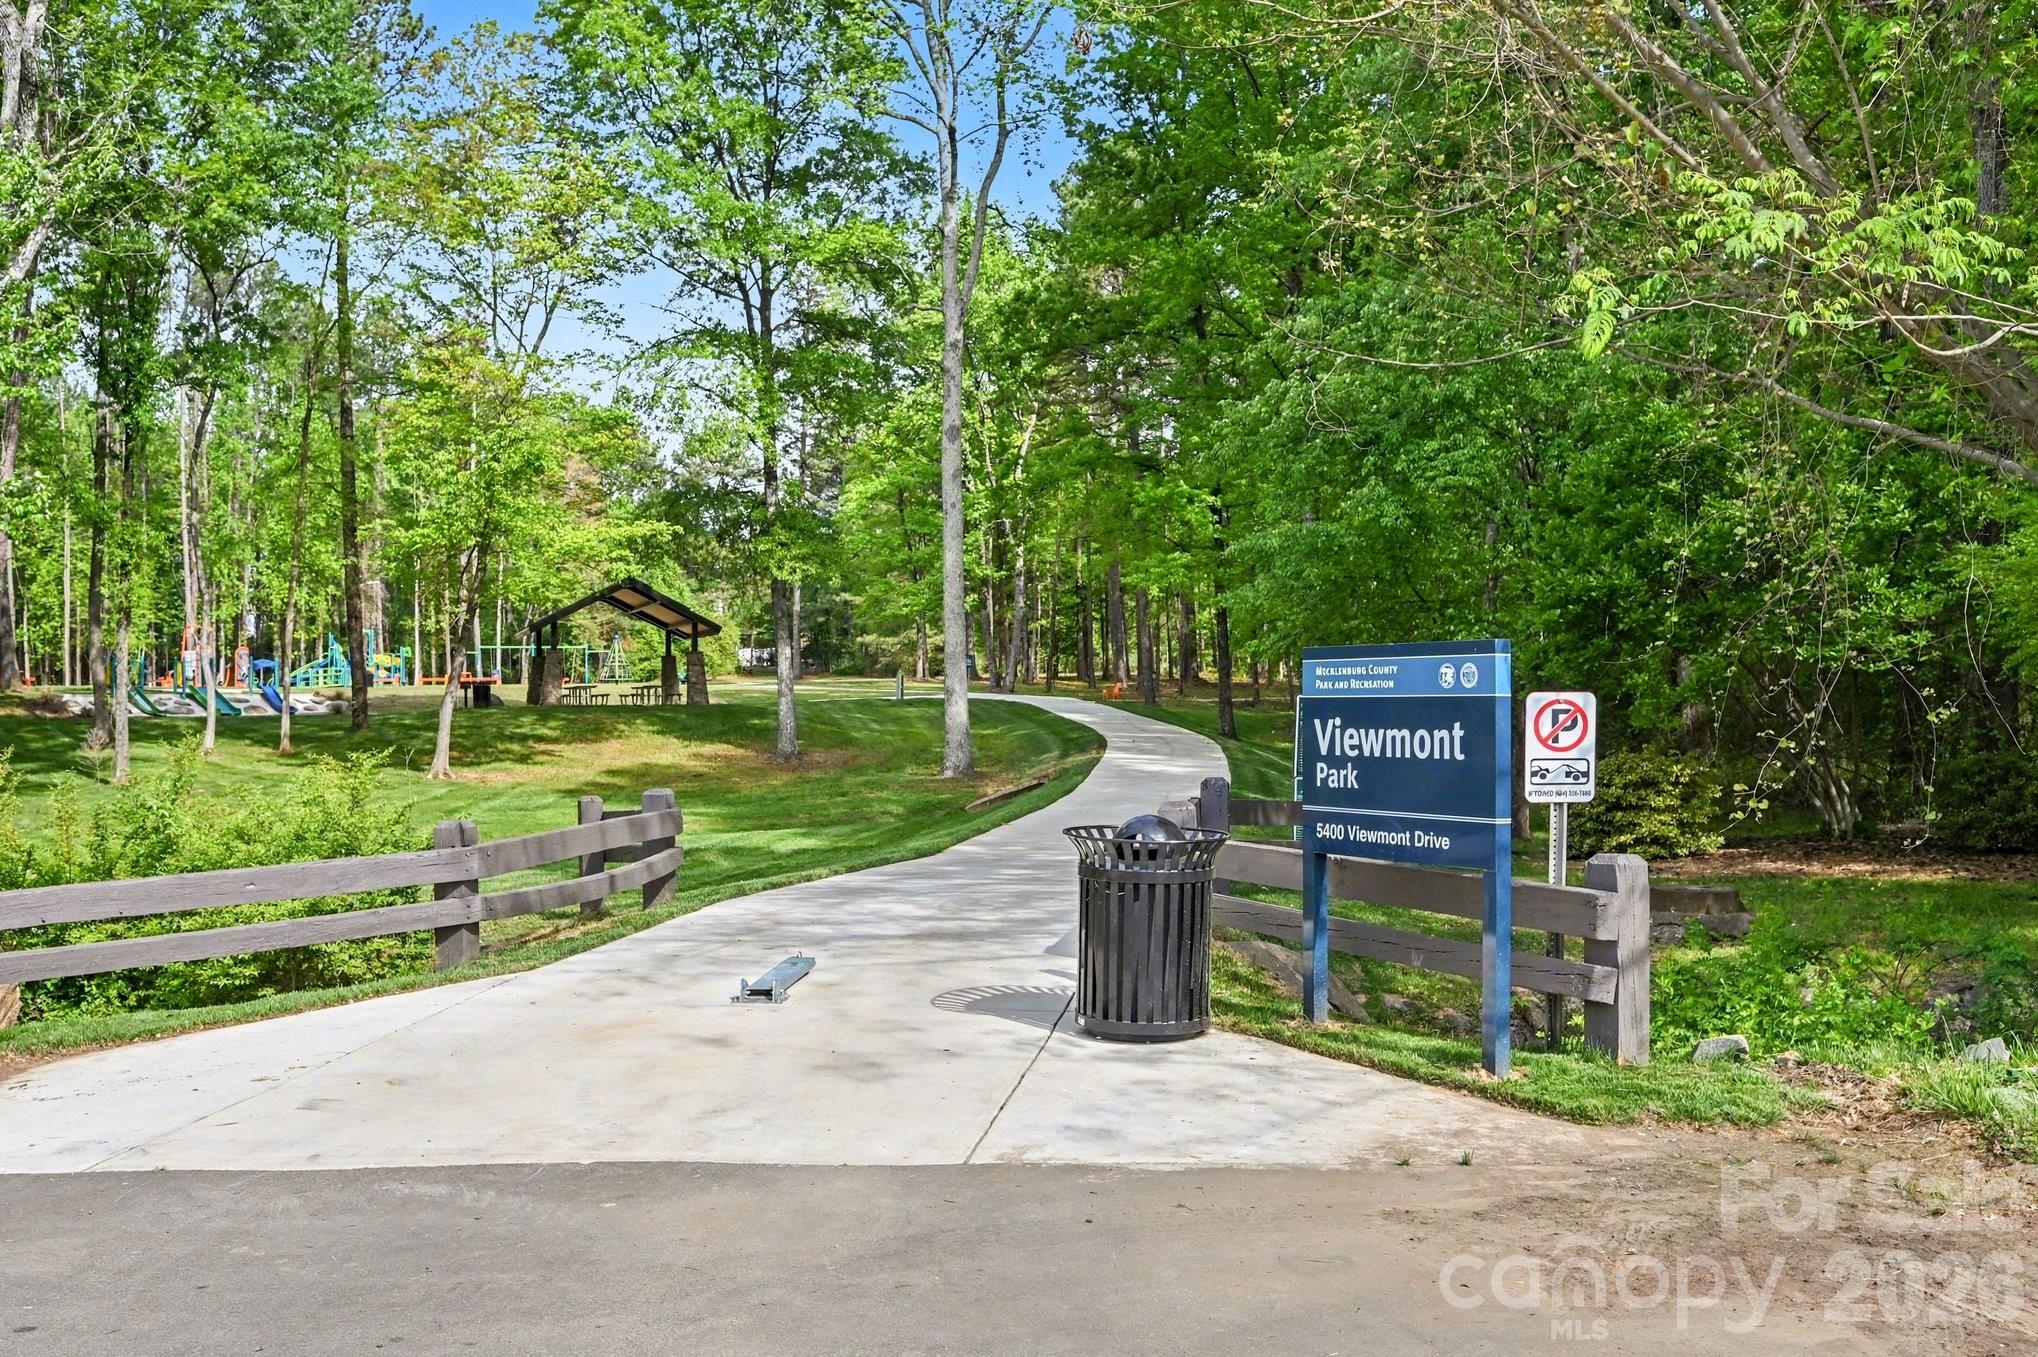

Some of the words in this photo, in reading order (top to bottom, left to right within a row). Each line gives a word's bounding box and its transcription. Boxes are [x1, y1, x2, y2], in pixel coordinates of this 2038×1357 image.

[1314, 716, 1466, 761] Viewmont
[1316, 762, 1359, 790] Park
[1315, 822, 1345, 841] 5400
[1347, 825, 1411, 847] Viewmont
[1414, 831, 1451, 851] Drive
